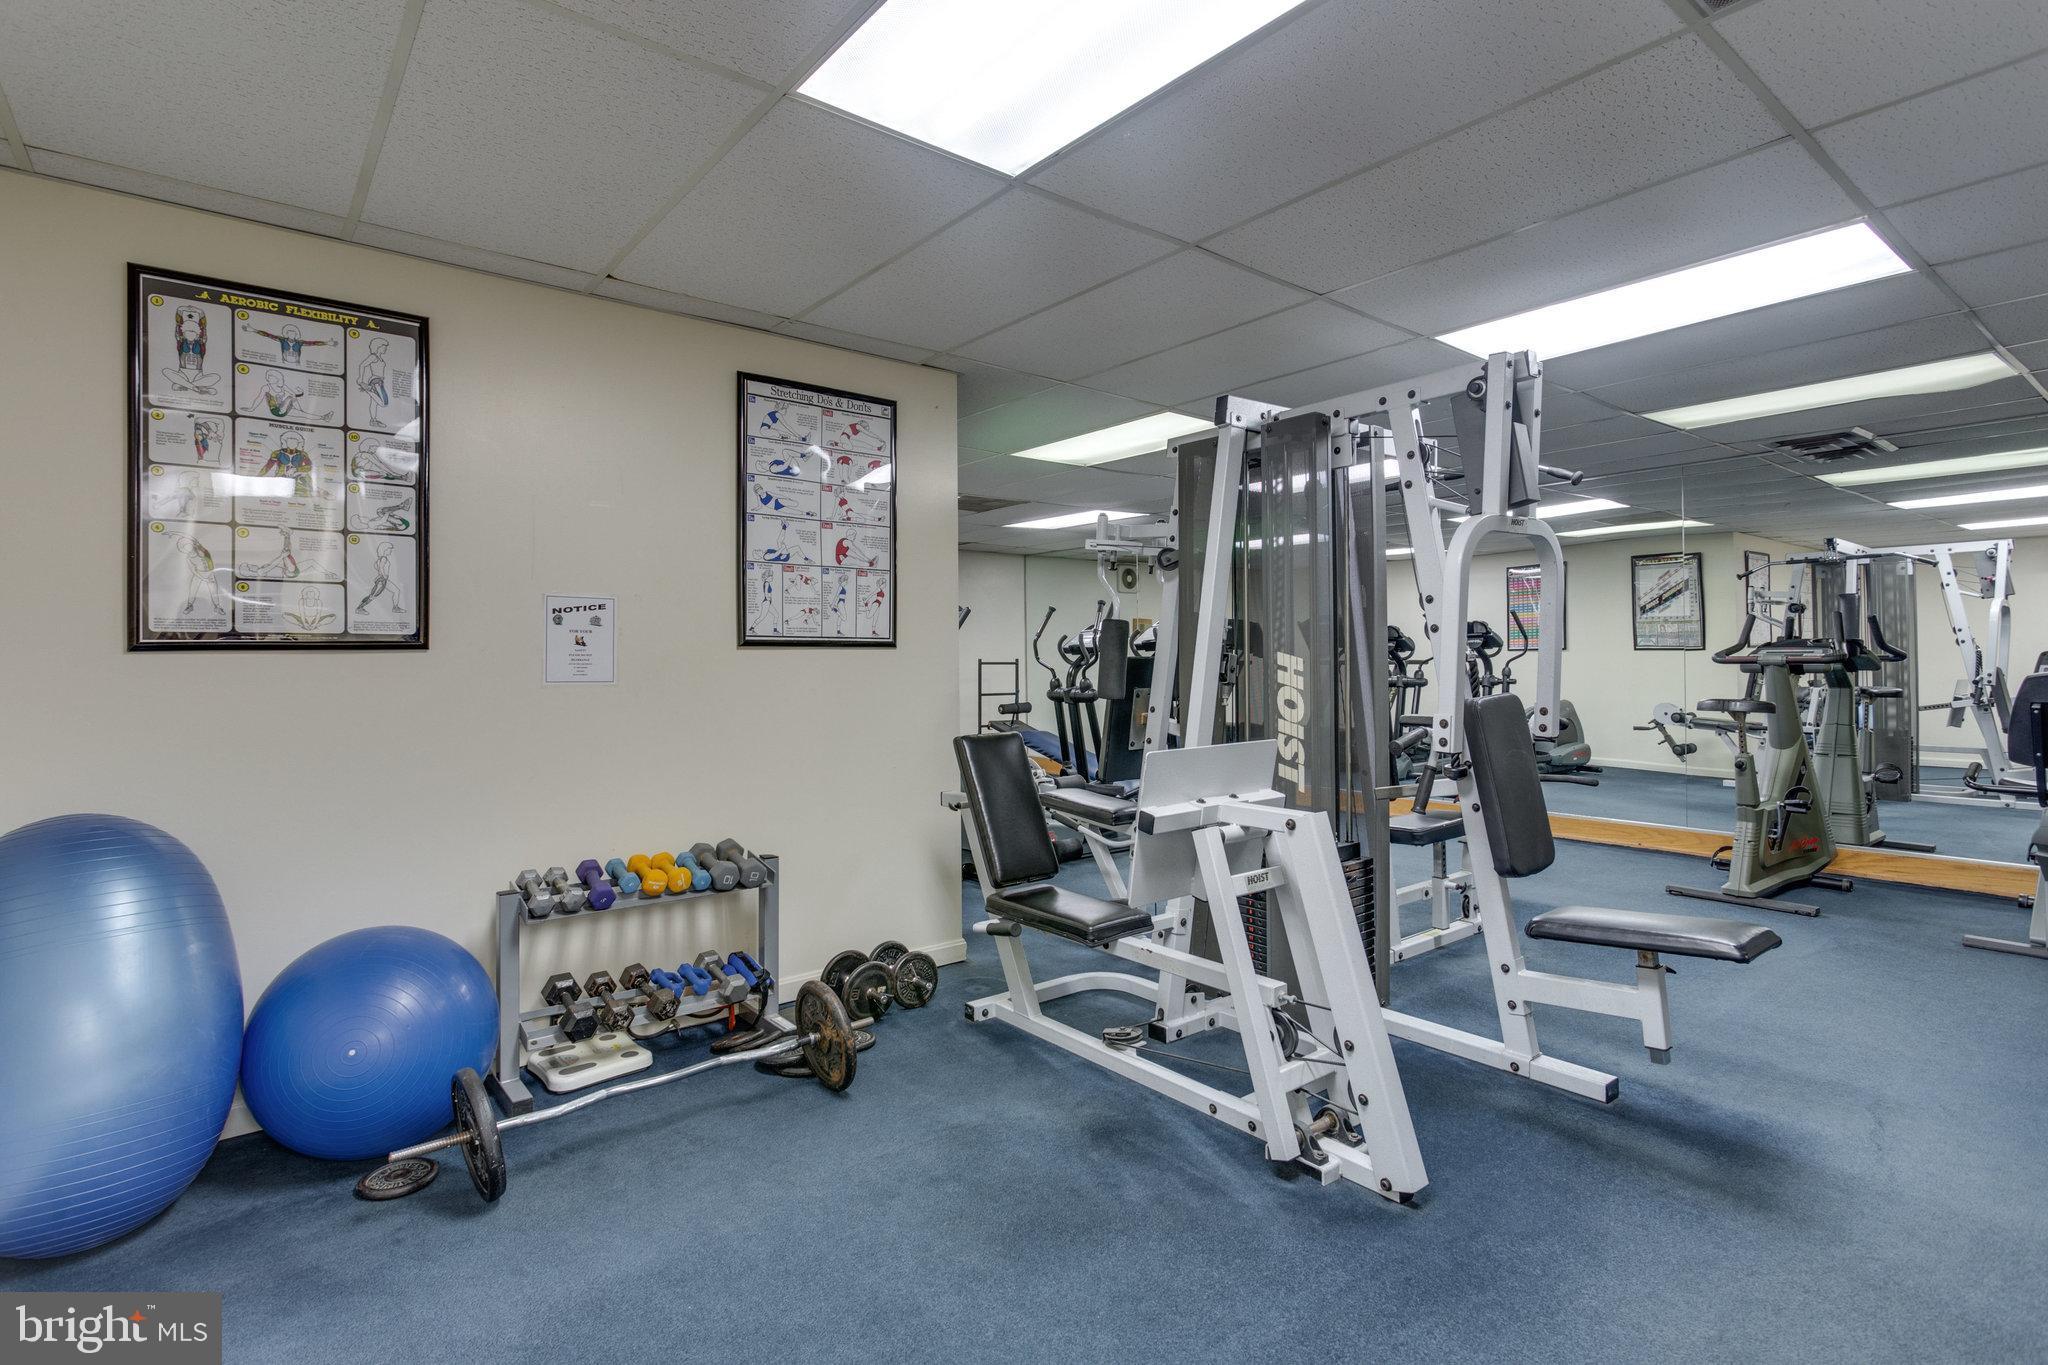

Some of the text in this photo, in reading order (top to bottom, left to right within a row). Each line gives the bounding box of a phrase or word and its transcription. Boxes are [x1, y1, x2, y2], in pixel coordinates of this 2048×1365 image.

[220, 294, 358, 325] AEROBIC FLEXIBILITY
[770, 386, 814, 404] Stretching
[835, 398, 843, 408] &
[846, 400, 871, 413] Don'ts
[552, 604, 606, 614] NOTICE
[1277, 652, 1305, 793] HOIST
[749, 872, 759, 882] 10
[1247, 872, 1269, 885] HOIST
